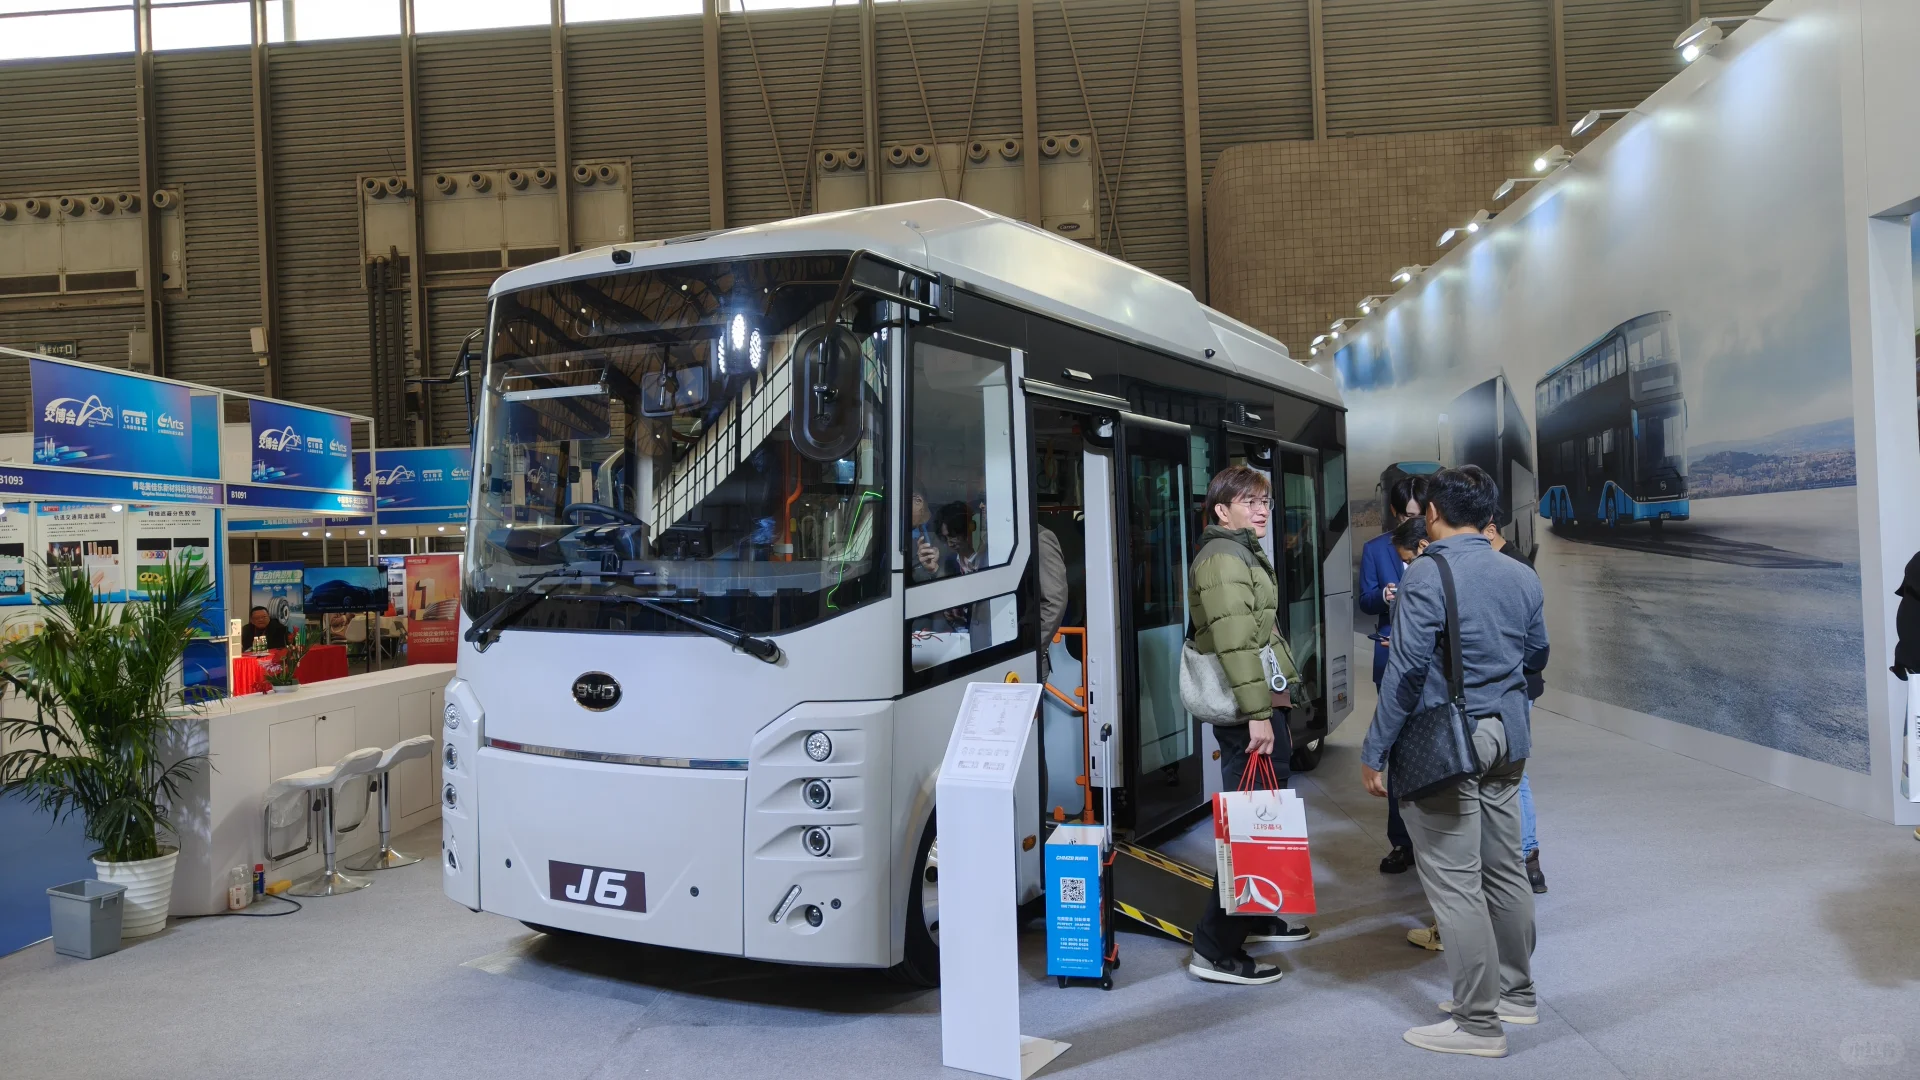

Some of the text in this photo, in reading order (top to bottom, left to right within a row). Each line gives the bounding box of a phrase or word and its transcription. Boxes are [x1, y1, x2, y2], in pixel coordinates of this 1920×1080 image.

[1082, 199, 1090, 210] 4
[618, 225, 625, 237] 5
[172, 250, 178, 261] 6
[47, 346, 64, 354] EXIT
[44, 405, 76, 425] 交博会
[123, 415, 147, 426] CIBE
[258, 436, 279, 451] 交博会
[307, 442, 323, 450] CIBE
[0, 474, 24, 486] B1093
[231, 490, 247, 500] B1091
[576, 683, 615, 699] BYD
[565, 868, 627, 906] J6
